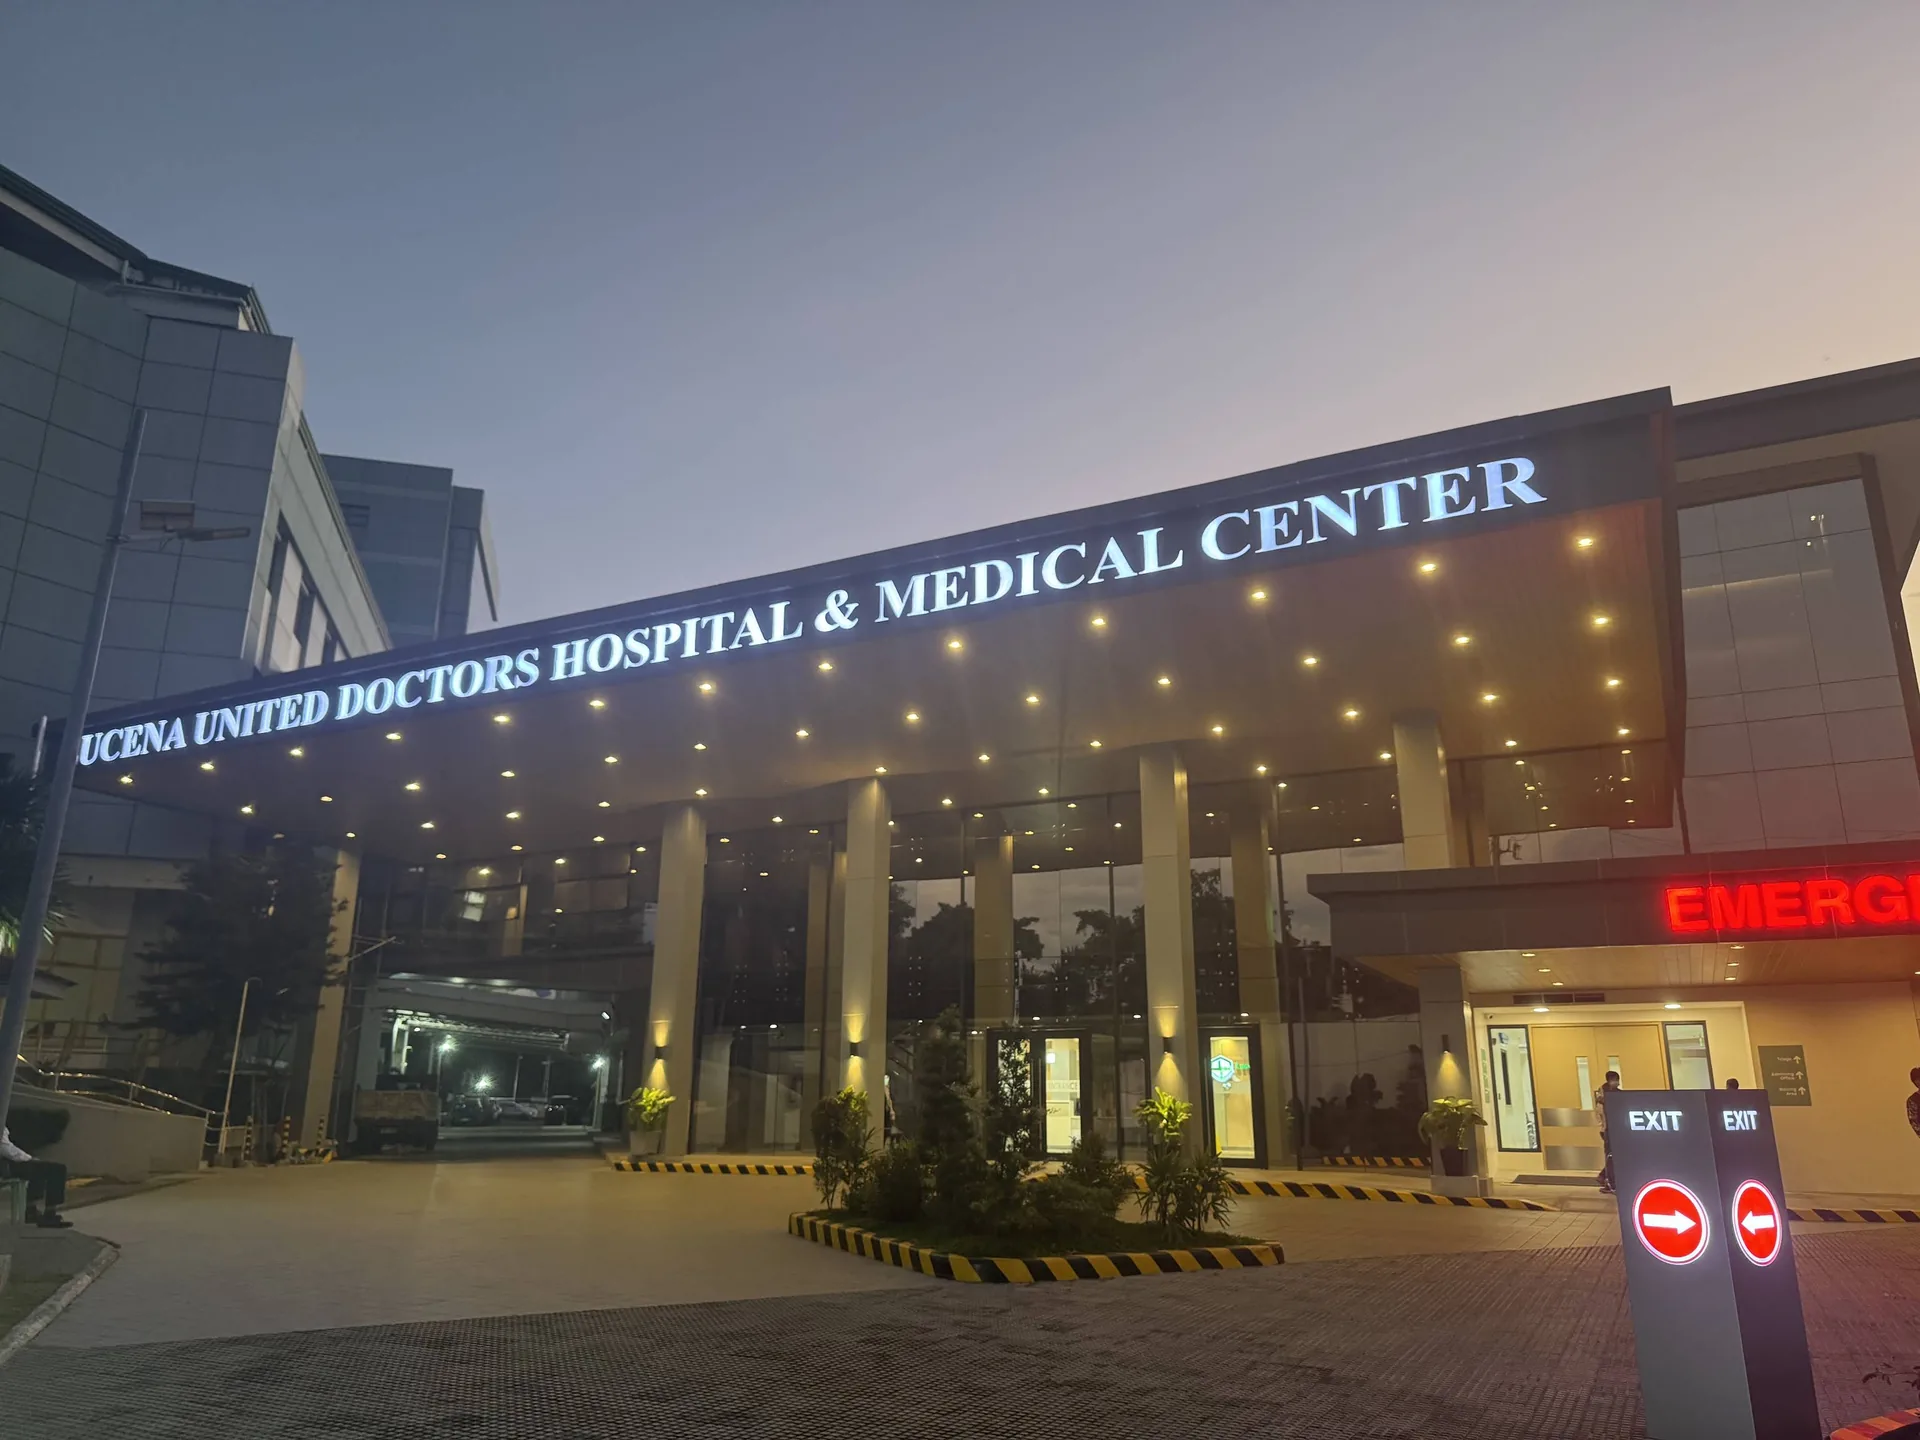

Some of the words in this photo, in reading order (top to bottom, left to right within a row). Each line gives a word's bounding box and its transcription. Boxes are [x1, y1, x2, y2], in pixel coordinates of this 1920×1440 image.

[76, 717, 188, 766] UCENA
[194, 690, 330, 746] UNITED
[334, 647, 540, 721] DOCTORS
[549, 600, 804, 682] HOSPITAL
[814, 589, 860, 633] &
[874, 527, 1184, 623] MEDICAL
[1200, 457, 1548, 561] CENTER
[1629, 1110, 1682, 1131] EXIT
[1723, 1110, 1757, 1131] EXIT
